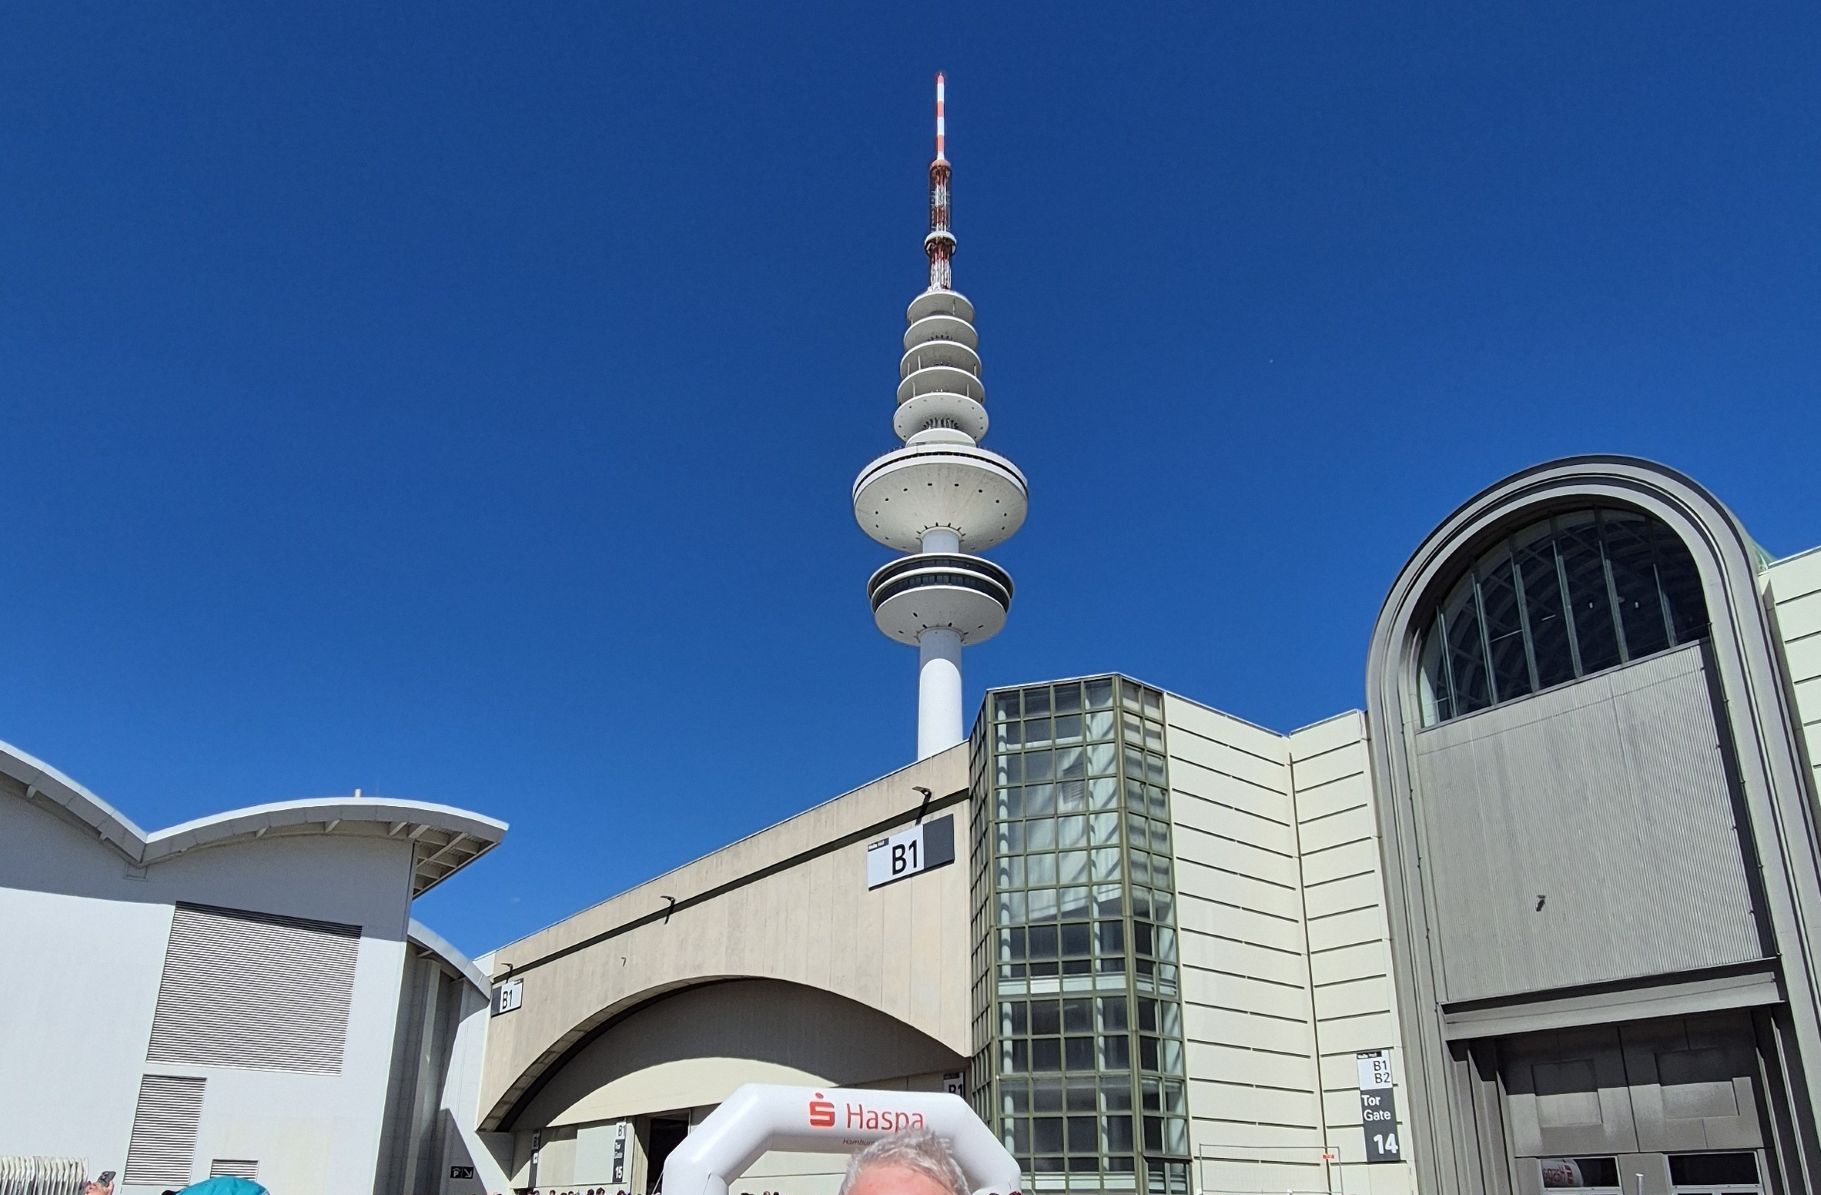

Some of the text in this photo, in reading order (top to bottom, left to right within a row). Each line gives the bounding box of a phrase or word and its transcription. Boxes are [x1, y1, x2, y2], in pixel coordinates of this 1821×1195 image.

[892, 839, 917, 876] B1
[502, 989, 513, 1009] B1
[1373, 1060, 1388, 1072] B1
[1374, 1072, 1390, 1083] B2
[1361, 1094, 1381, 1106] Tor
[846, 1103, 924, 1133] Haspa
[1363, 1109, 1391, 1121] Gate
[1373, 1132, 1399, 1155] 14
[615, 1166, 623, 1179] 15
